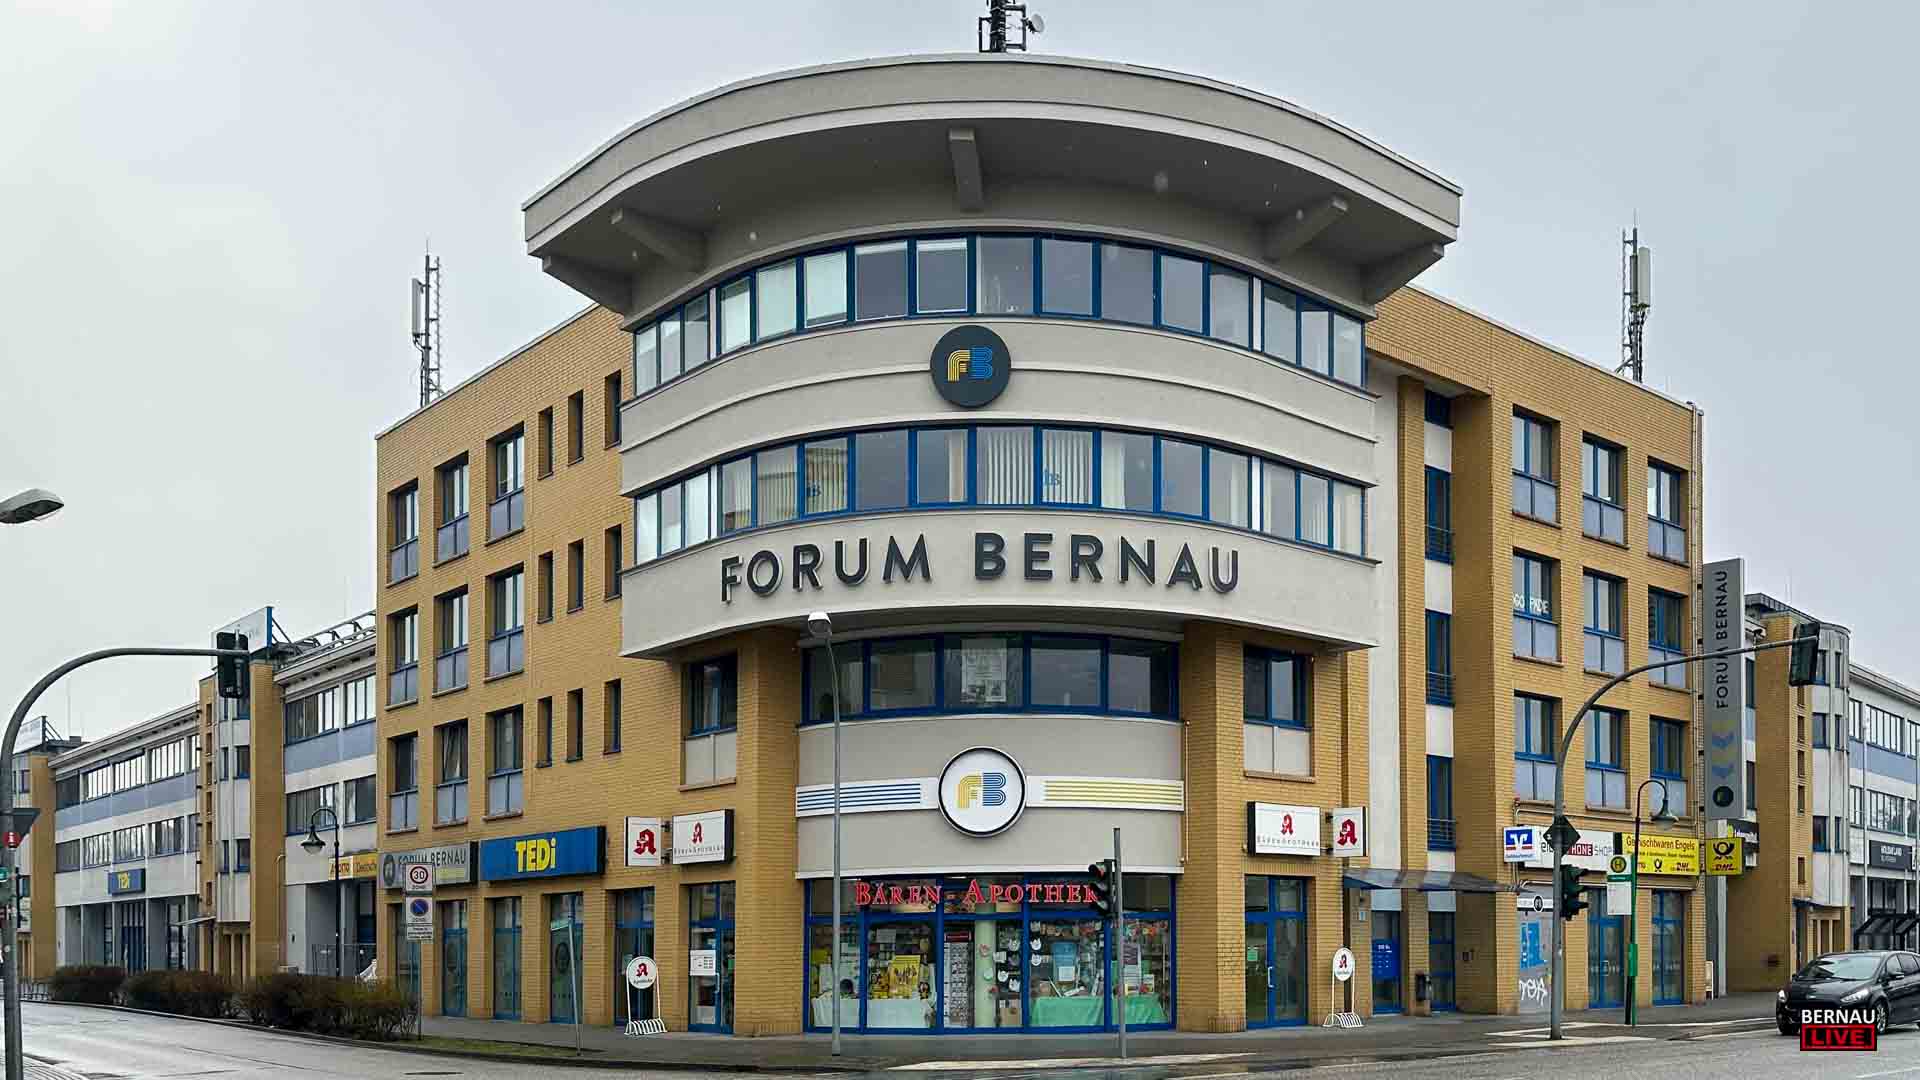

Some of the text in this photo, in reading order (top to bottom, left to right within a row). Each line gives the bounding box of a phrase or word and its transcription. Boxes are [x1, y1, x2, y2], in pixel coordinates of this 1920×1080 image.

[721, 532, 1238, 603] FORUM BERNAU
[1715, 569, 1729, 640] BERNAU
[957, 772, 1007, 809] FB
[430, 847, 467, 867] BERNAU
[515, 837, 557, 873] TEDi
[1675, 839, 1695, 852] Engels
[413, 870, 425, 880] 30
[855, 879, 943, 906] BÄREN
